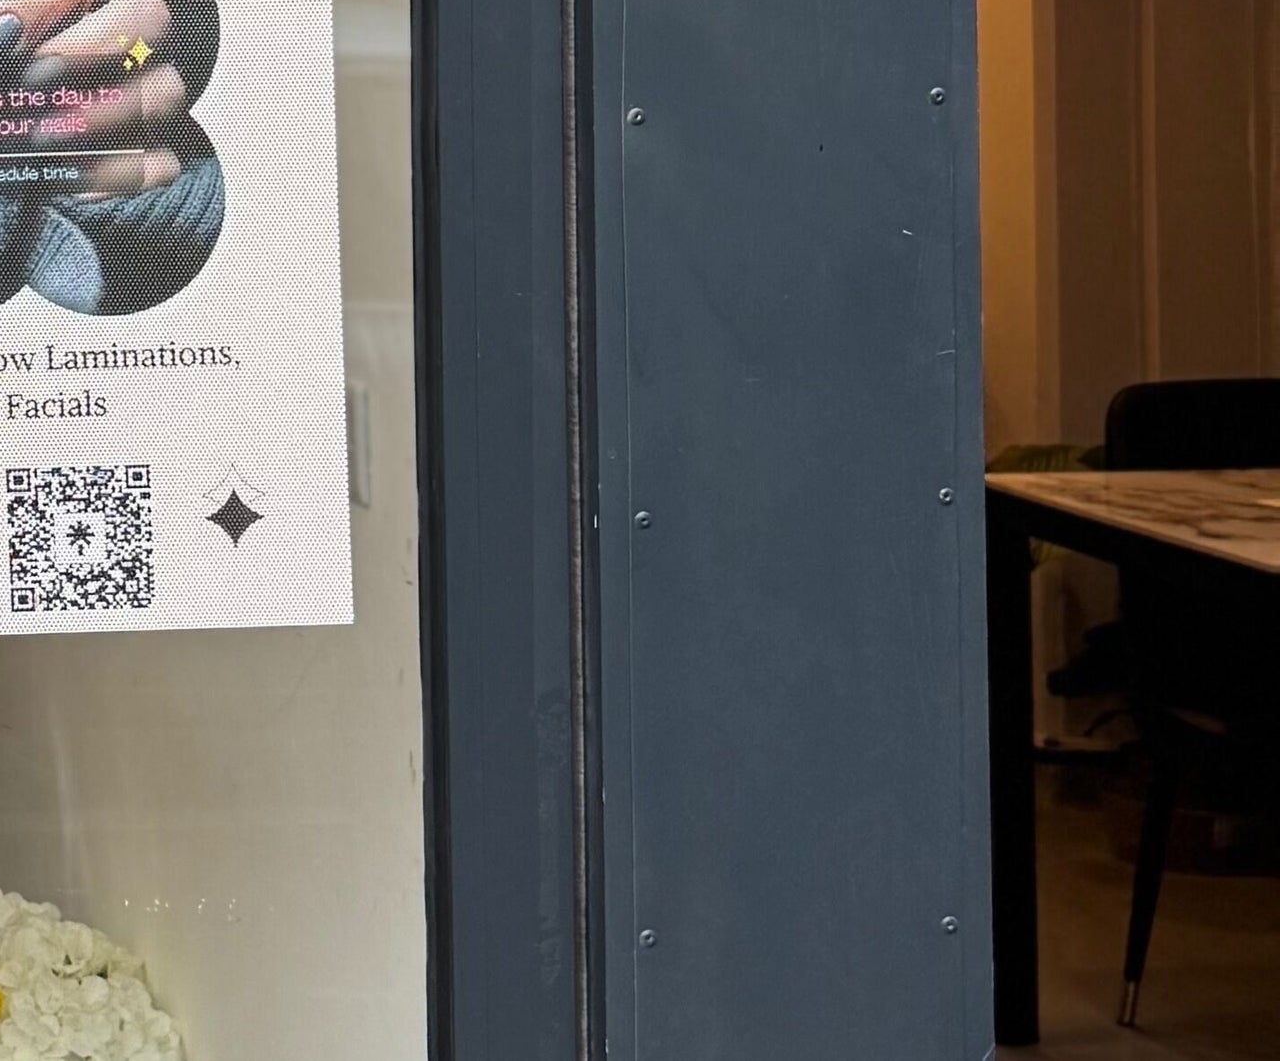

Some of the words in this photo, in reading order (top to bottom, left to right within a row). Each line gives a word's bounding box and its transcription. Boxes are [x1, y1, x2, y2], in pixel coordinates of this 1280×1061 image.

[9, 88, 46, 108] the
[51, 86, 94, 109] day
[99, 87, 123, 104] to
[43, 165, 79, 181] time
[45, 340, 241, 371] Laminations,
[6, 389, 108, 421] Facials
